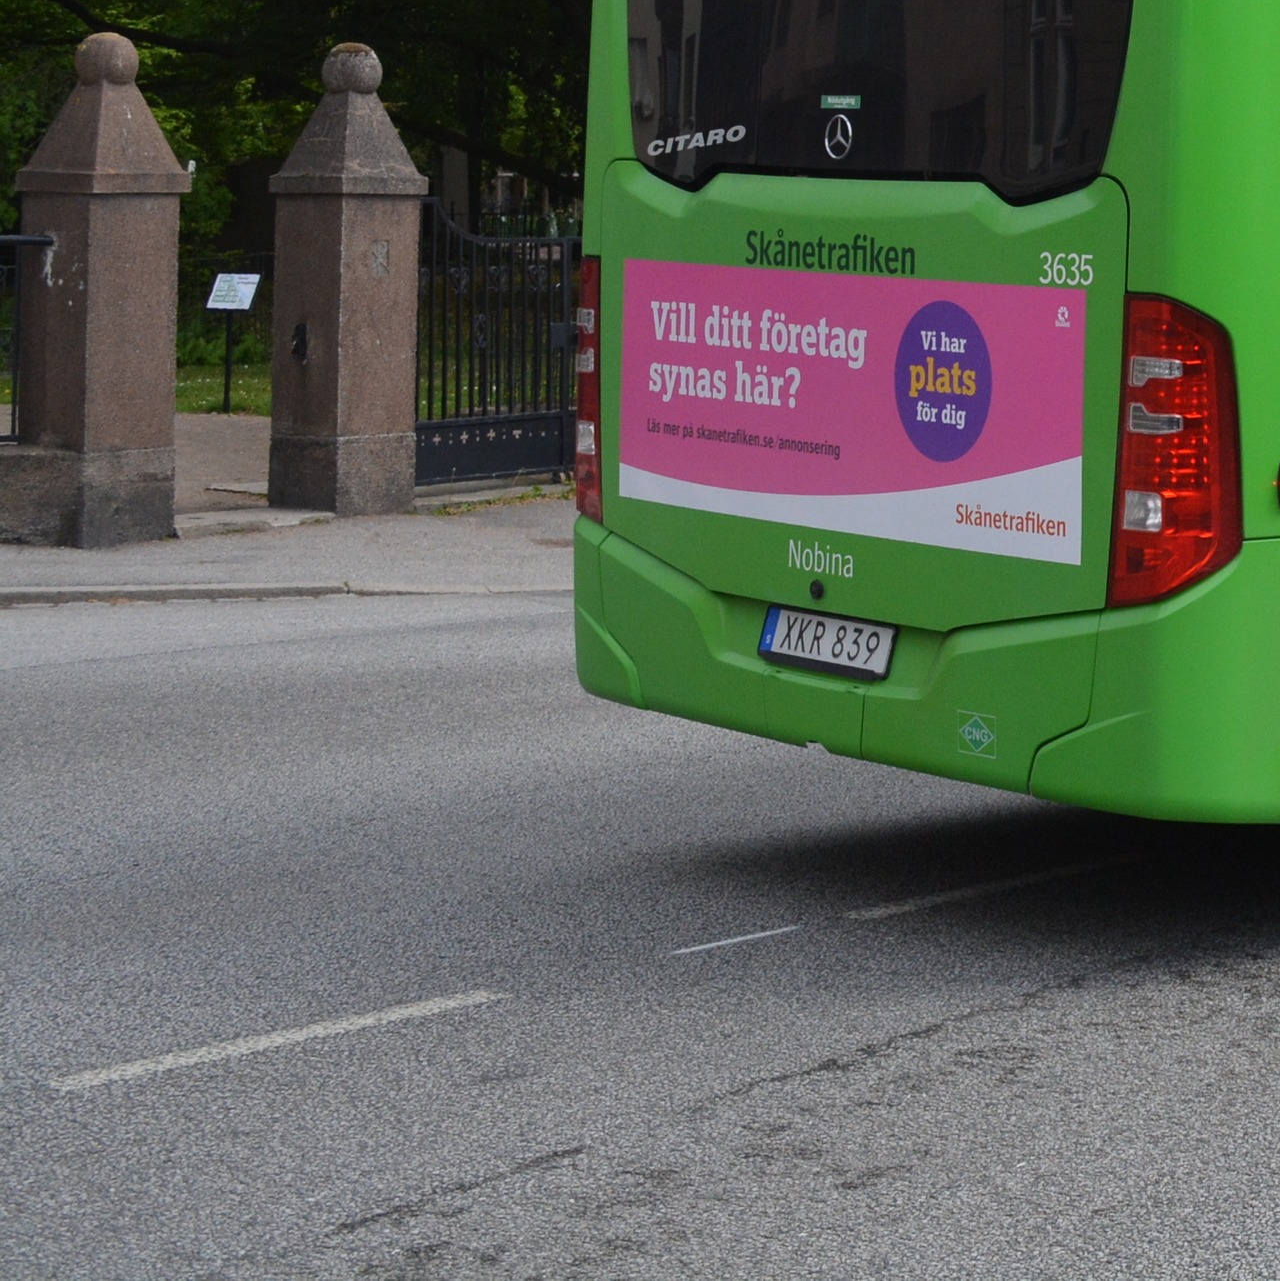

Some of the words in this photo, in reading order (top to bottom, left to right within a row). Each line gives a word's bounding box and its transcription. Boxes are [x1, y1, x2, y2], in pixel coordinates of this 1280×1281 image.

[647, 125, 747, 157] CITARO
[745, 228, 917, 276] Skånetrafiken
[1038, 251, 1095, 286] 3635
[651, 300, 697, 344] Vill
[704, 305, 752, 350] ditt
[759, 309, 868, 370] företag
[920, 330, 938, 351] Vi
[940, 331, 968, 354] har
[648, 361, 727, 403] synas
[735, 360, 802, 409] här?
[908, 356, 977, 398] plats
[647, 417, 661, 434] Läs
[663, 422, 681, 437] mer
[683, 421, 695, 440] på
[916, 400, 938, 423] för
[941, 404, 967, 430] dig
[954, 503, 1068, 538] Skånetrafiken
[787, 538, 855, 579] Nobina
[765, 634, 772, 645] S
[779, 614, 827, 657] XKR
[831, 625, 881, 665] 839
[963, 725, 990, 744] CNG
